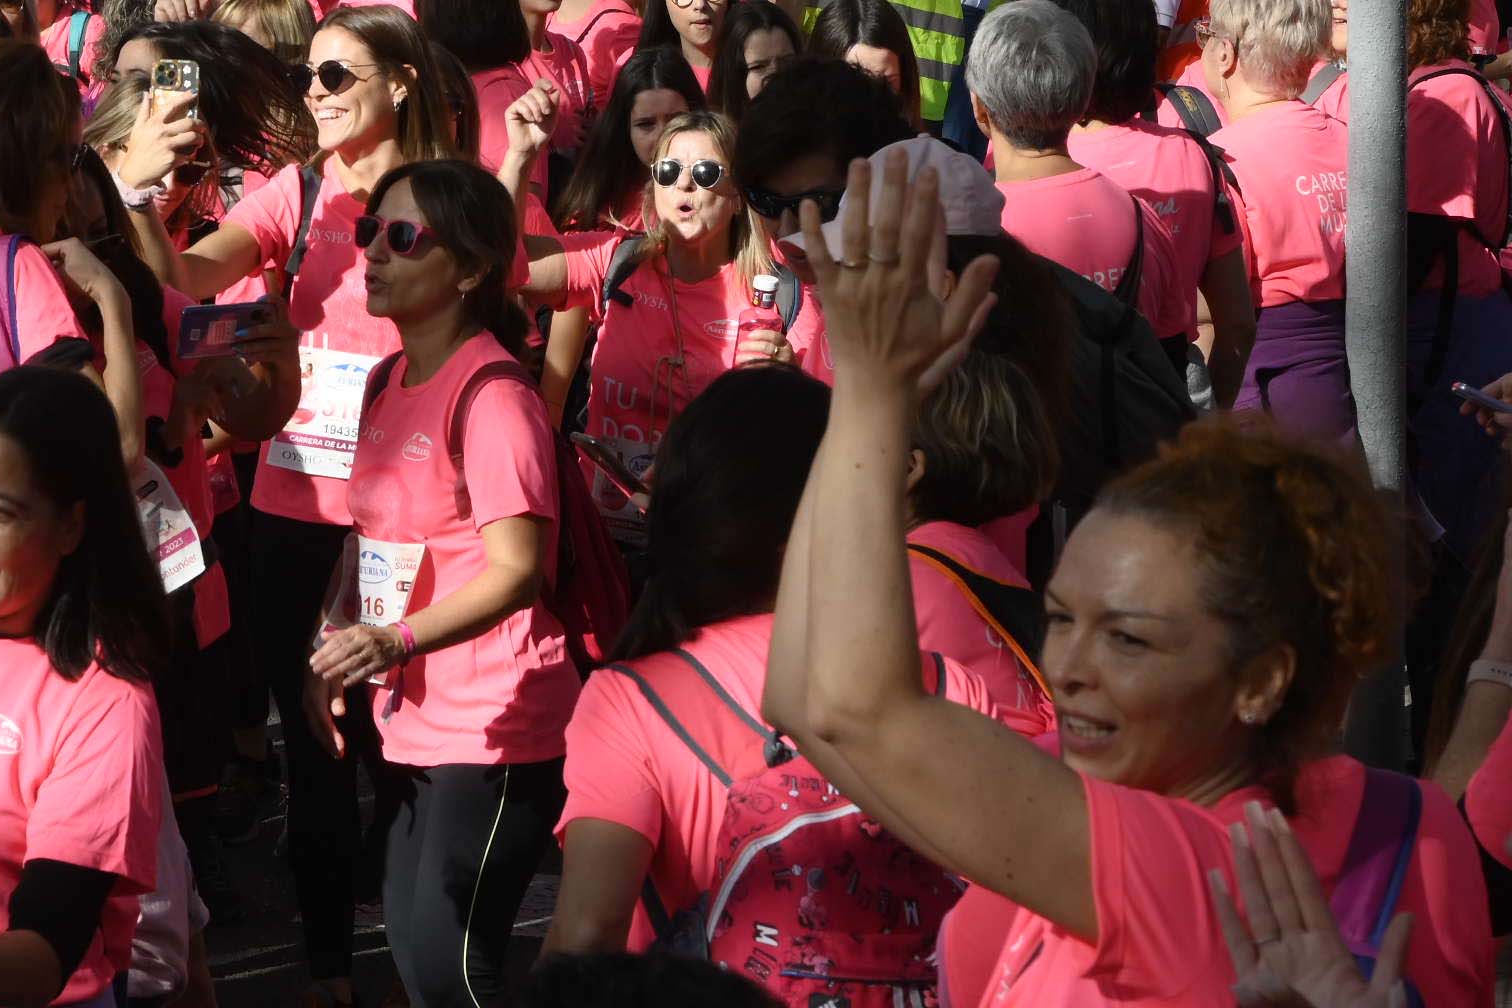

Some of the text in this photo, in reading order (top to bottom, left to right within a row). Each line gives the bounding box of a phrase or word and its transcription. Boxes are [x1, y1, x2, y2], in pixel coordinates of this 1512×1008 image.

[1317, 194, 1336, 214] DE
[603, 376, 637, 410] TU
[290, 435, 322, 446] CARRERA
[324, 440, 336, 448] DE
[337, 441, 347, 450] LA
